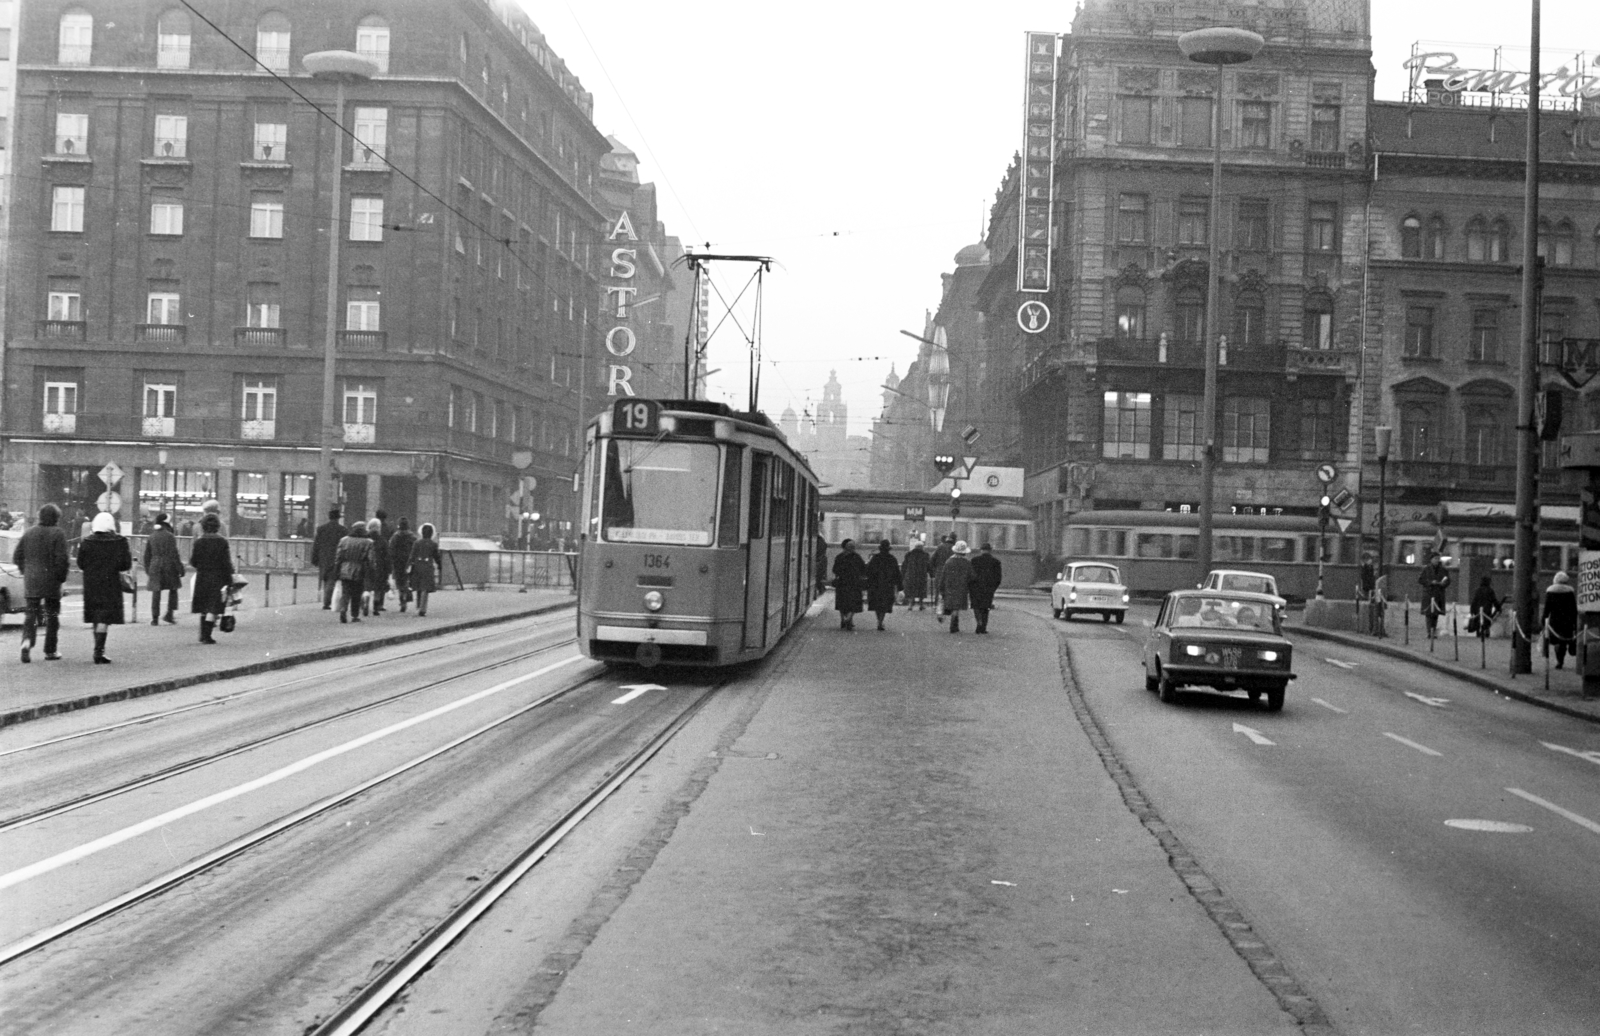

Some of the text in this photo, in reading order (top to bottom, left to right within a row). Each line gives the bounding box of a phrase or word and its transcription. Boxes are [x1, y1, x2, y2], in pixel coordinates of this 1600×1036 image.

[606, 211, 639, 396] ASTOR
[622, 403, 648, 428] 19
[644, 554, 671, 568] 1364
